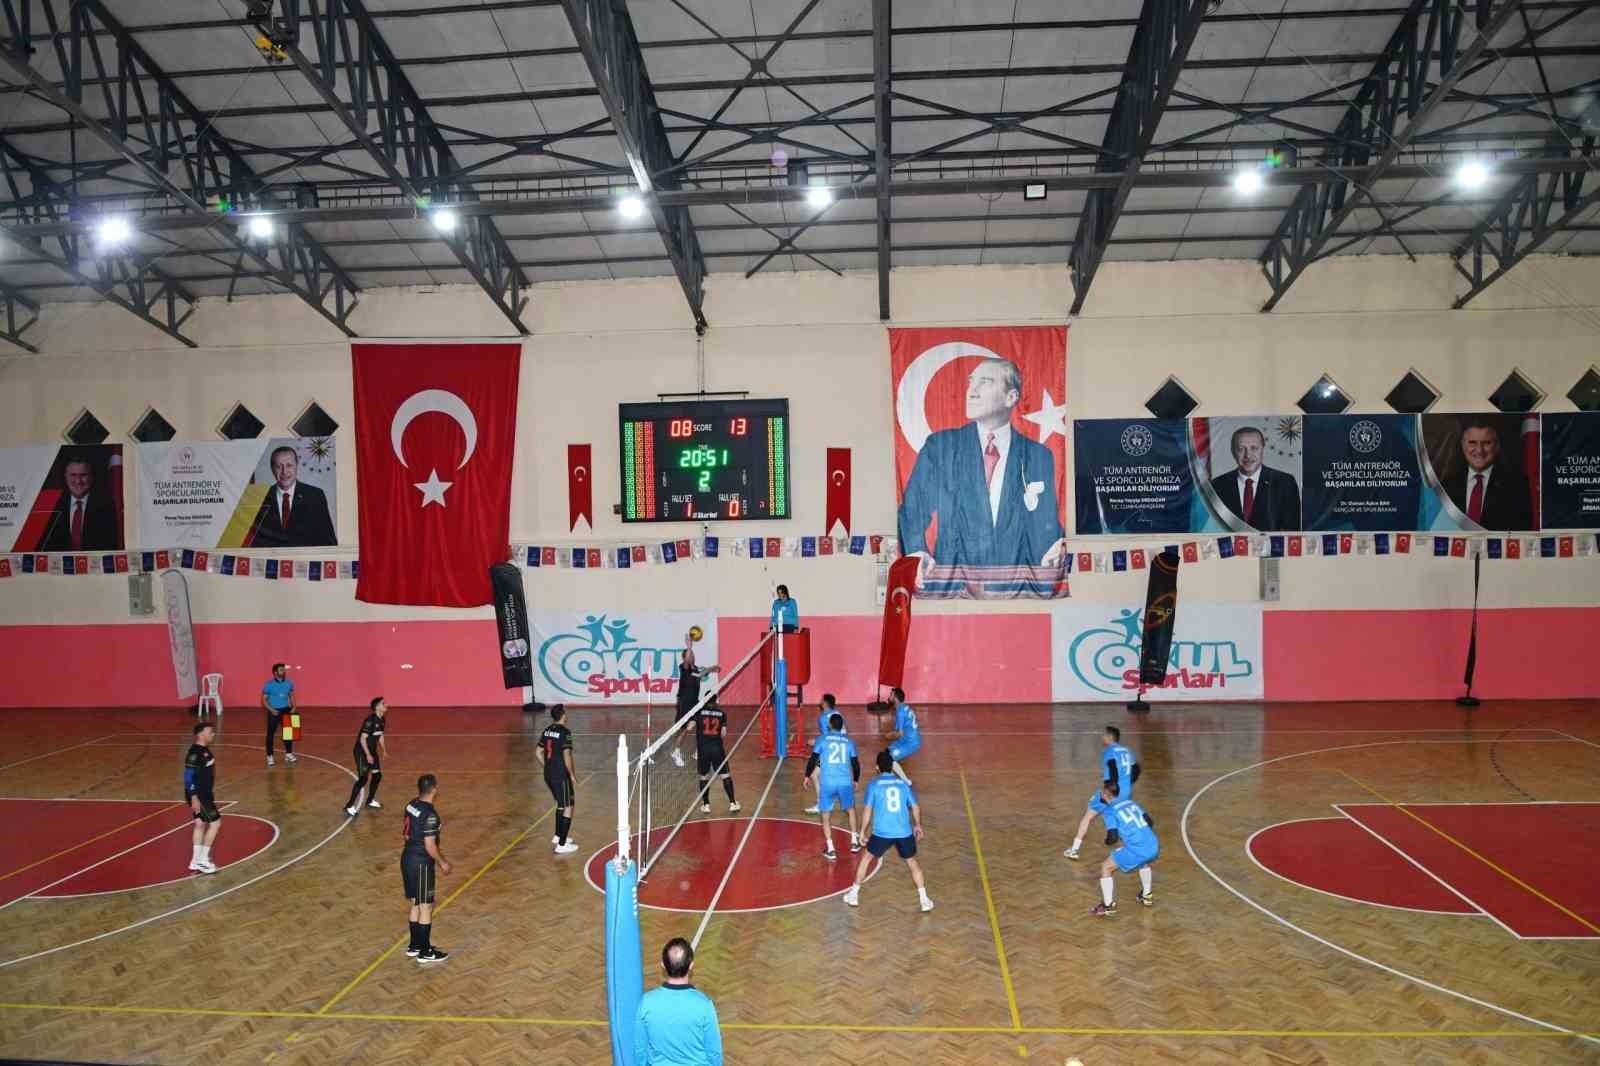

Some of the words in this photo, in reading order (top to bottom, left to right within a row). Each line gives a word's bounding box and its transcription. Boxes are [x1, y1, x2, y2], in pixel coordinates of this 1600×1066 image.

[671, 420, 692, 437] 08
[692, 423, 712, 432] SCORE
[730, 418, 746, 435] 13
[680, 450, 728, 467] 20:51
[1568, 456, 1588, 465] TÜM
[1104, 465, 1122, 474] TÜM
[1125, 465, 1171, 474] ANTRENÖR
[1332, 462, 1351, 470] TÜM
[1354, 461, 1400, 470] ANTRENÖR
[1555, 465, 1568, 473] VE
[699, 471, 710, 487] 2
[1322, 471, 1335, 479] VE
[1336, 470, 1410, 479] SPORCULARIMIZA
[154, 480, 171, 488] TÜM
[1094, 476, 1104, 485] VE
[1106, 475, 1181, 485] SPORCULARIMIZA
[1325, 480, 1365, 488] BAŞARILAR
[1367, 479, 1407, 487] DİLİYORUM
[157, 488, 221, 497] SPORCULARIMIZA
[1096, 485, 1137, 493] BAŞARILAR
[1138, 484, 1180, 492] DİLİYORUM
[153, 498, 188, 506] BAŞARILAR
[189, 496, 224, 504] DİLİYORUM
[729, 500, 739, 517] 0
[828, 742, 847, 764] 21
[886, 786, 901, 813] 8
